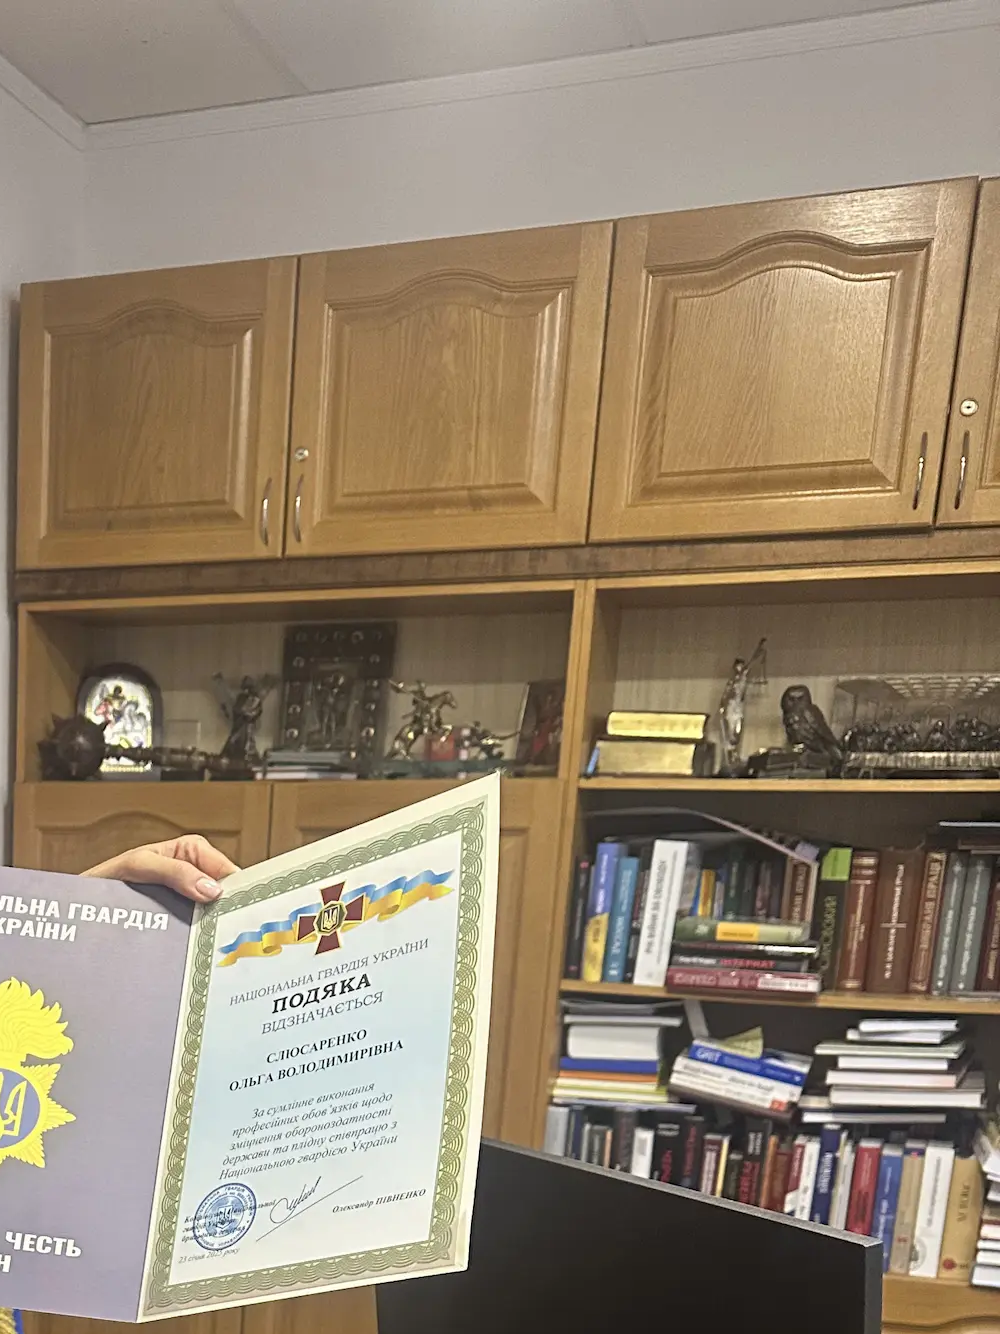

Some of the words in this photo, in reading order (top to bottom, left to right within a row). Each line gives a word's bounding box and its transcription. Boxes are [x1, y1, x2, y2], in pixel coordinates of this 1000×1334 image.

[67, 902, 169, 931] ГВАРДІЯ
[229, 973, 314, 1007] НАЦІОНАЛЬНА
[317, 956, 369, 982] ГВАРДІЯ
[372, 938, 430, 965] УКРАЇНИ
[271, 973, 372, 1014] ПОДЯКА
[261, 990, 384, 1035] ВІДЗНАЧАЄТЬСЯ
[229, 1072, 275, 1092] ОЛЬГА
[277, 1040, 404, 1081] ВОЛОДИМИРІВНА
[266, 1028, 367, 1064] СЛЮСАРЕНКО
[232, 1114, 299, 1138] професійних
[361, 1092, 393, 1110] щодо
[252, 1108, 265, 1119] За
[266, 1097, 314, 1119] сумлінне
[316, 1082, 376, 1104] виконання
[222, 1148, 270, 1167] держави
[272, 1144, 289, 1155] та
[291, 1135, 327, 1154] плідну
[328, 1122, 389, 1147] співпрацю
[390, 1120, 398, 1131] з
[229, 1131, 282, 1152] зміцнення
[285, 1107, 393, 1139] обороноздатності
[218, 1156, 296, 1181] Національною
[297, 1145, 348, 1165] гвардією
[350, 1133, 399, 1153] України
[332, 1200, 374, 1213] Олександр
[375, 1188, 427, 1206] ПІВНЕНКО
[5, 1231, 82, 1258] ЧЕСТЬ
